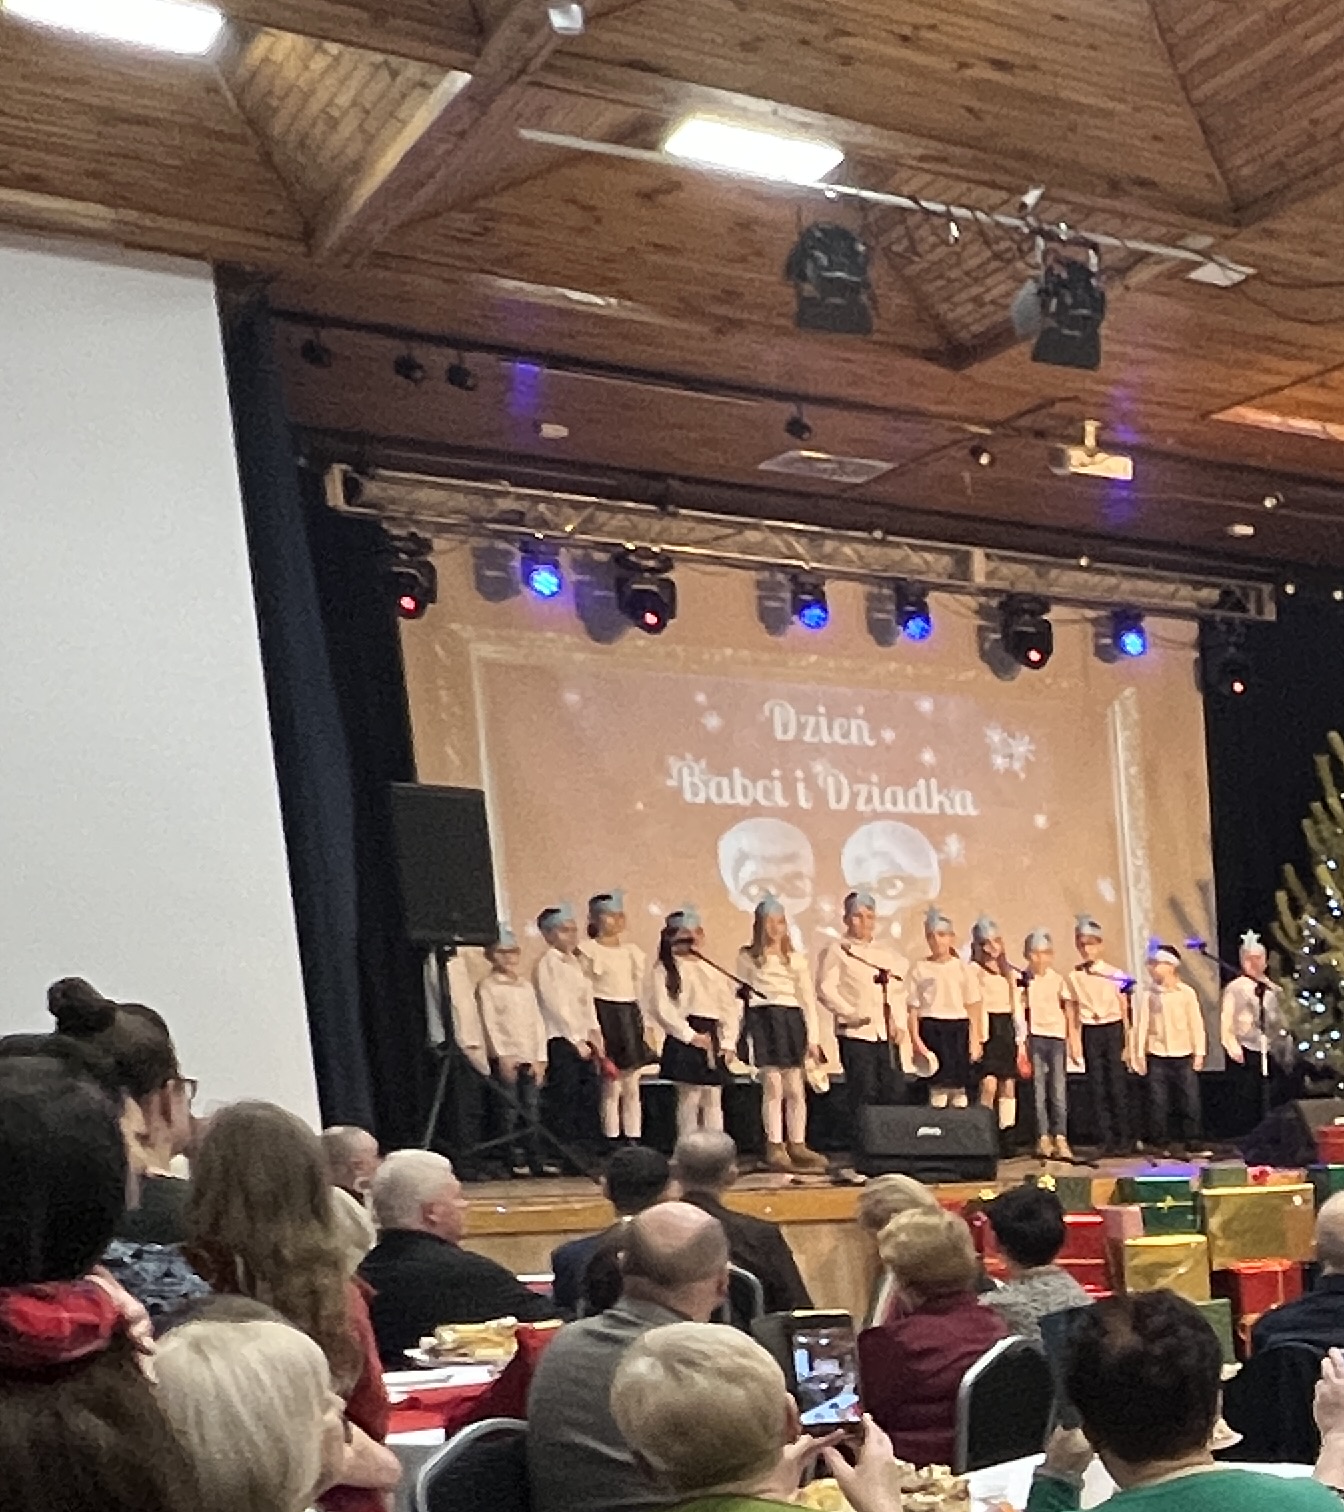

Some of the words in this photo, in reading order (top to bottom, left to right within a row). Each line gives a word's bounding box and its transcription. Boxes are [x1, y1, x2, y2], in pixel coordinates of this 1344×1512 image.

[763, 700, 876, 746] Dzień
[672, 761, 789, 807] Babci
[795, 768, 813, 809] i
[818, 769, 981, 815] Dziadka
